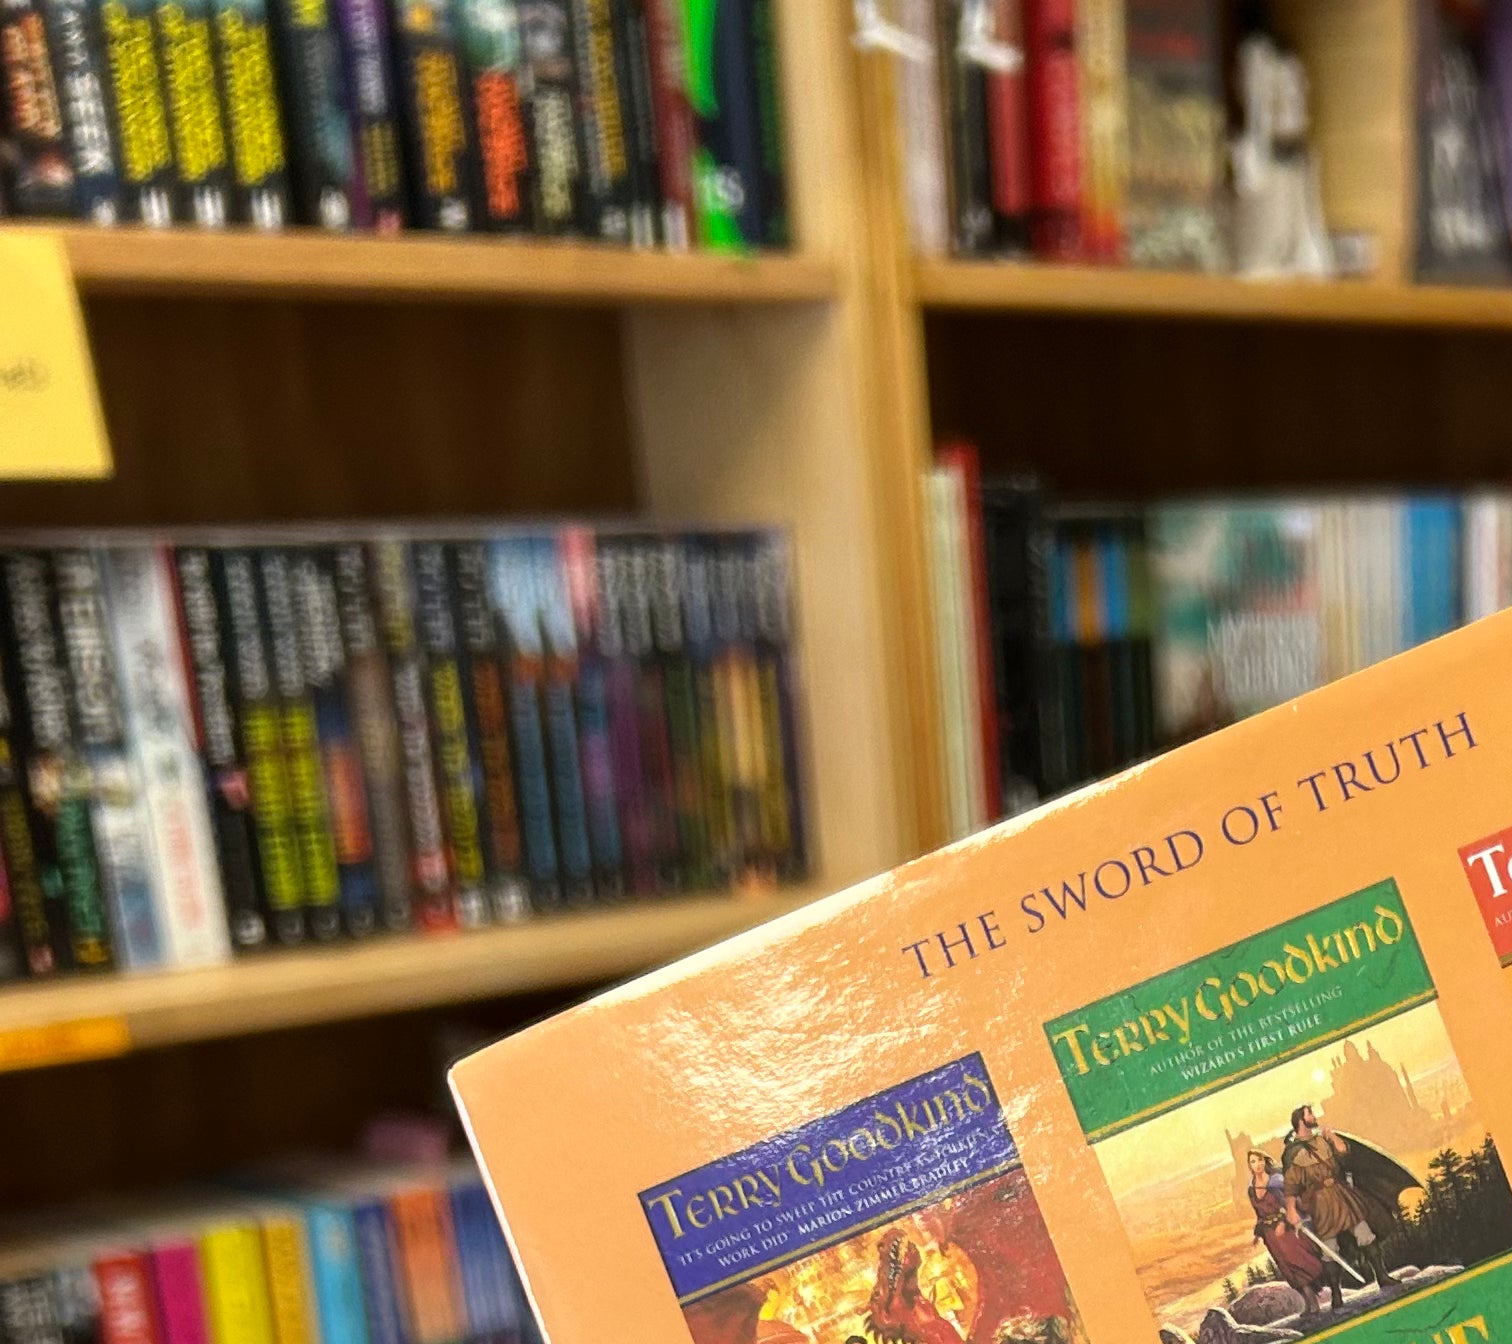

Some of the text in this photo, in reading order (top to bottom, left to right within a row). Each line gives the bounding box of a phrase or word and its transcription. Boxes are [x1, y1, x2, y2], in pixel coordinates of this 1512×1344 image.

[902, 712, 1478, 979] THE SWORD OF TRUTH
[1150, 985, 1343, 1075] AUTHOR OF THE BESTSELLING
[1180, 1013, 1322, 1081] WIZARD'S FIRST RULE
[706, 1228, 751, 1255] GOING
[753, 1219, 773, 1234] TO
[818, 1189, 845, 1208] THE
[718, 1246, 760, 1267] WORK
[797, 1205, 852, 1235] MARION
[857, 1184, 911, 1211] ZIMMER
[911, 1157, 969, 1189] BRADLEY
